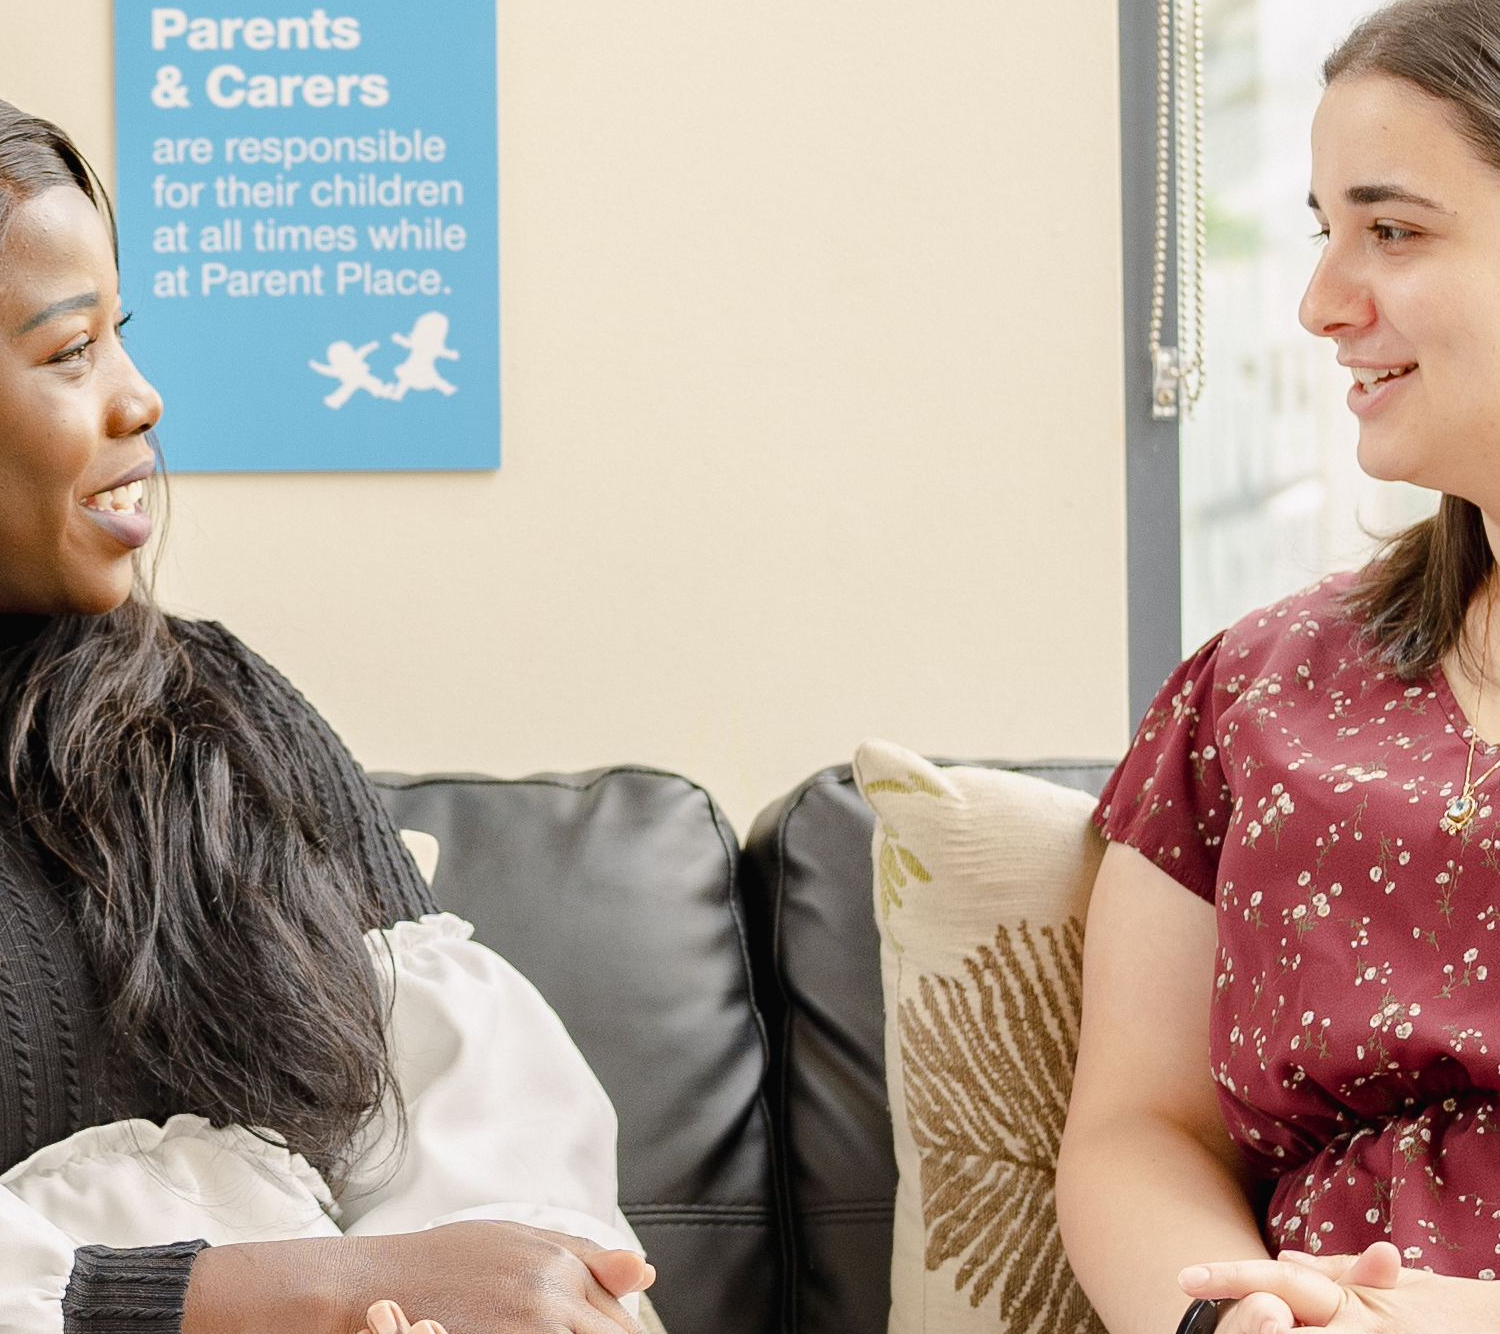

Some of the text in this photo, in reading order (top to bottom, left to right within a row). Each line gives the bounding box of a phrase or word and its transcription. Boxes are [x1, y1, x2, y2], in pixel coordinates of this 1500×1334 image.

[151, 8, 361, 51] Parents
[151, 64, 390, 109] & Carers
[152, 129, 447, 171] are responsible
[152, 173, 464, 209] for their children
[152, 218, 467, 254] at all times while
[153, 261, 452, 298] at Parent Place.
